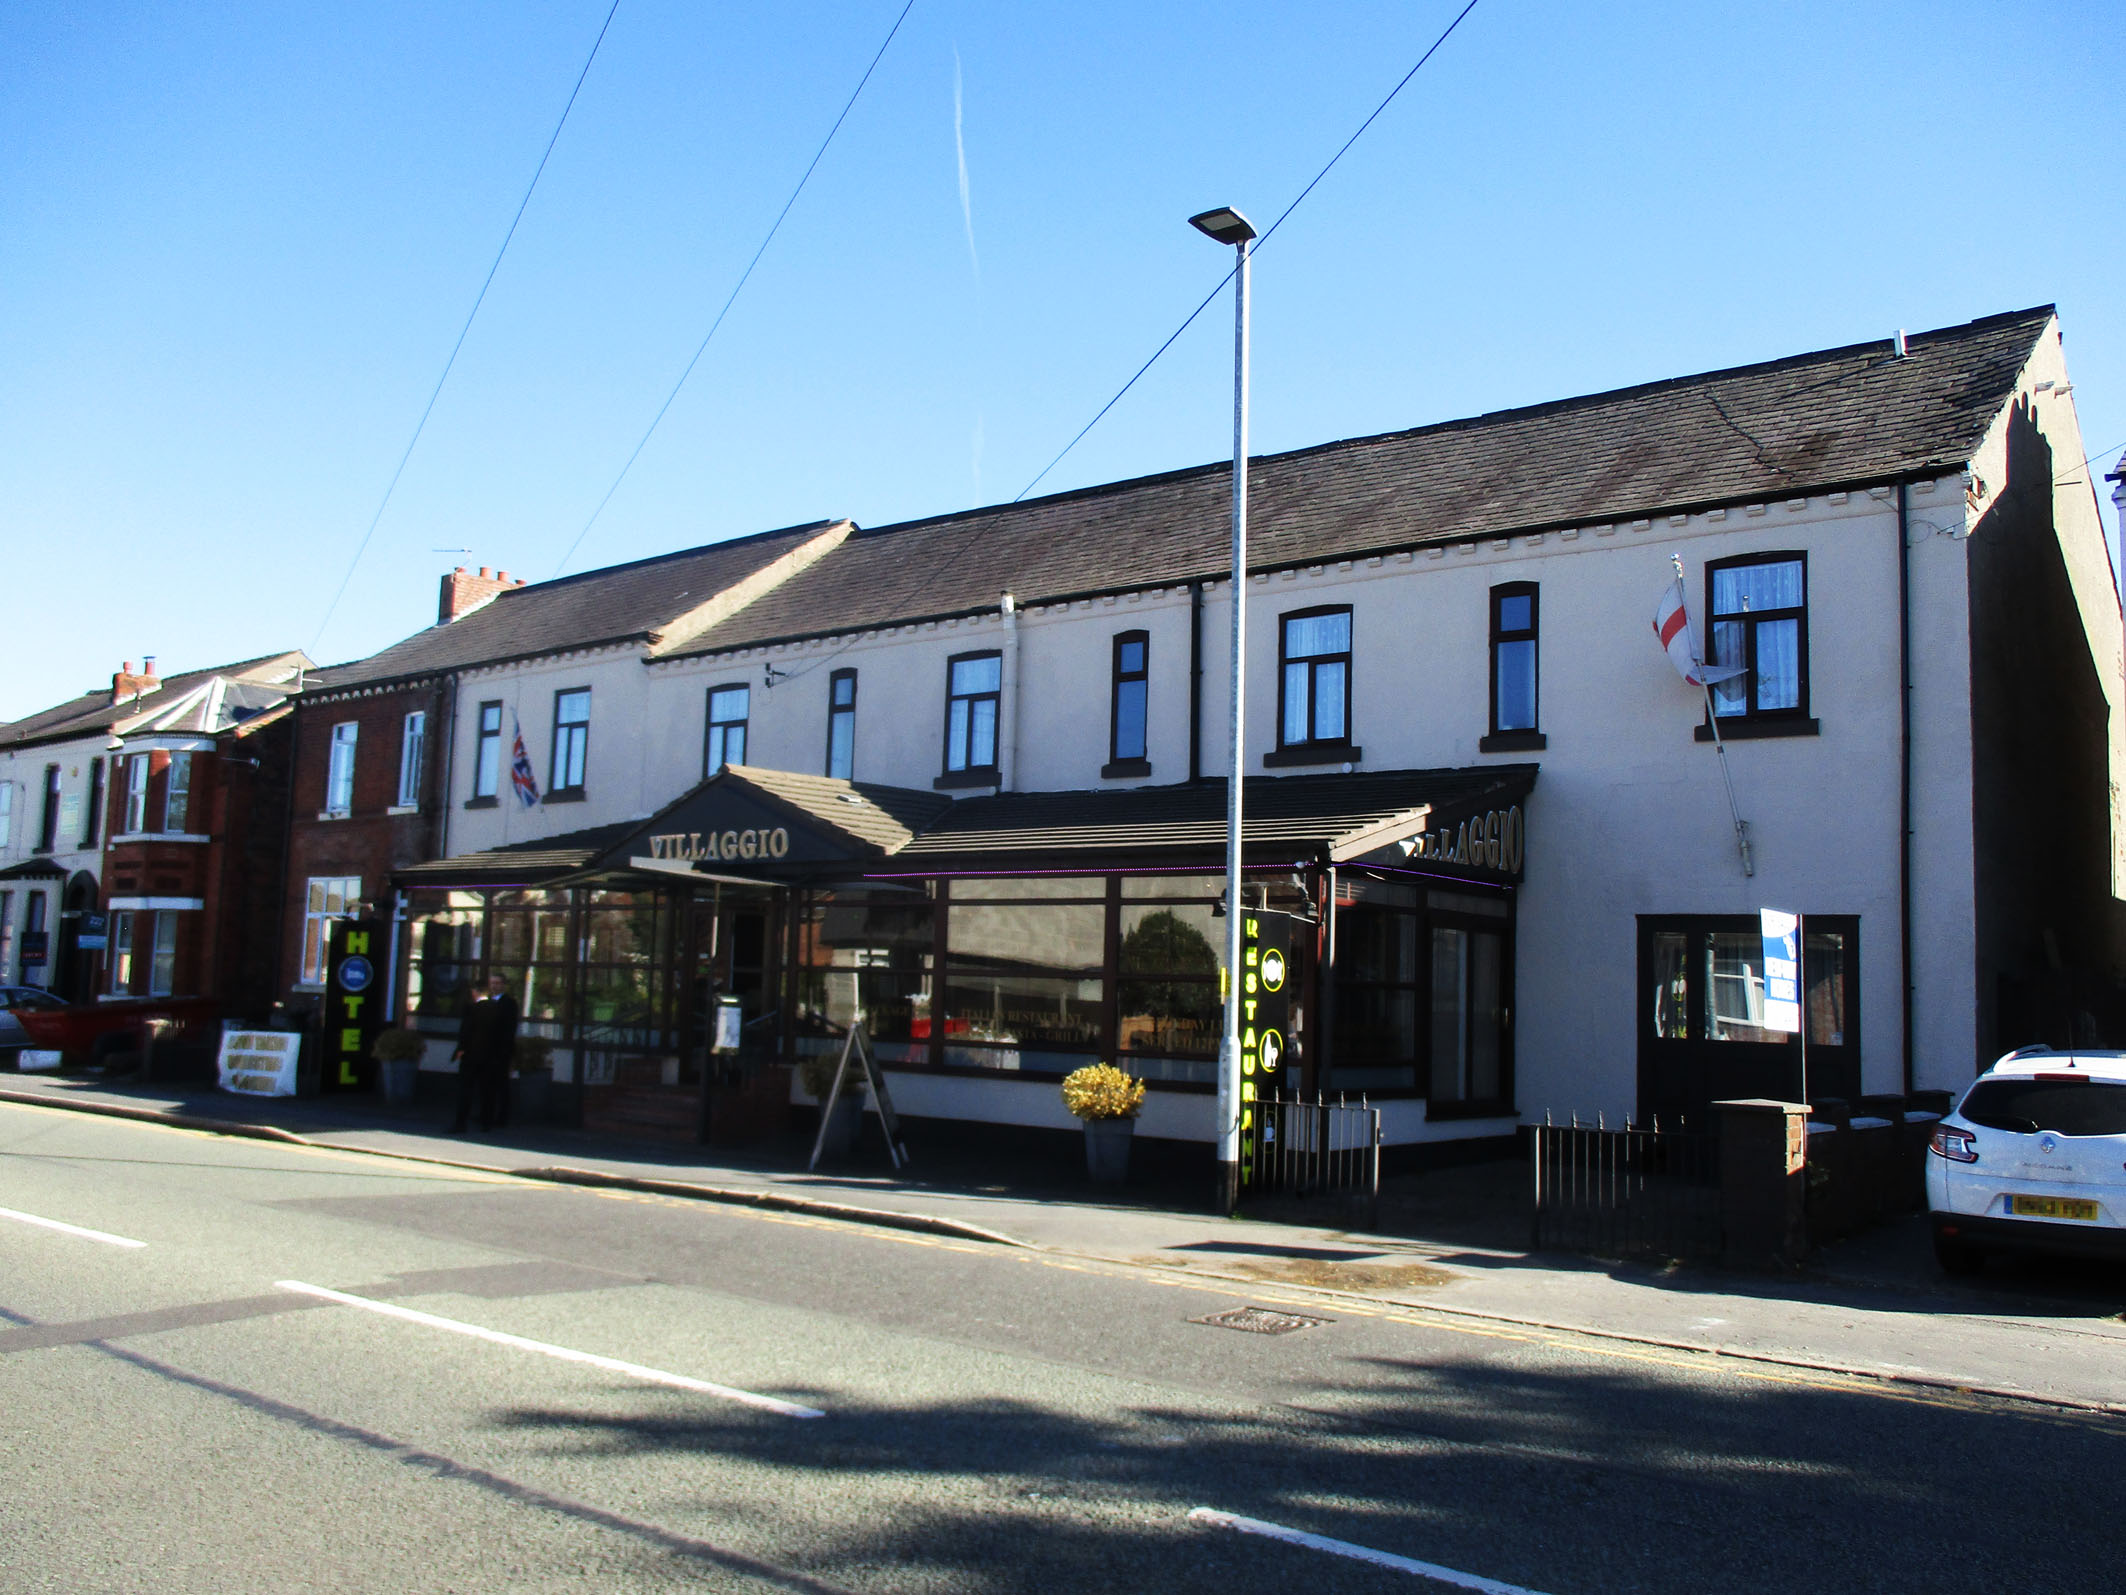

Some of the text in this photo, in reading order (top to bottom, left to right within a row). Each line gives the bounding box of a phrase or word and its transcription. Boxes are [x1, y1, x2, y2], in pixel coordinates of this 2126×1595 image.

[649, 827, 790, 861] VILLAGGIO
[1398, 804, 1524, 875] VILLAGGIO
[960, 1007, 1004, 1022] ITALIN
[1240, 917, 1260, 1187] RESTAURANT
